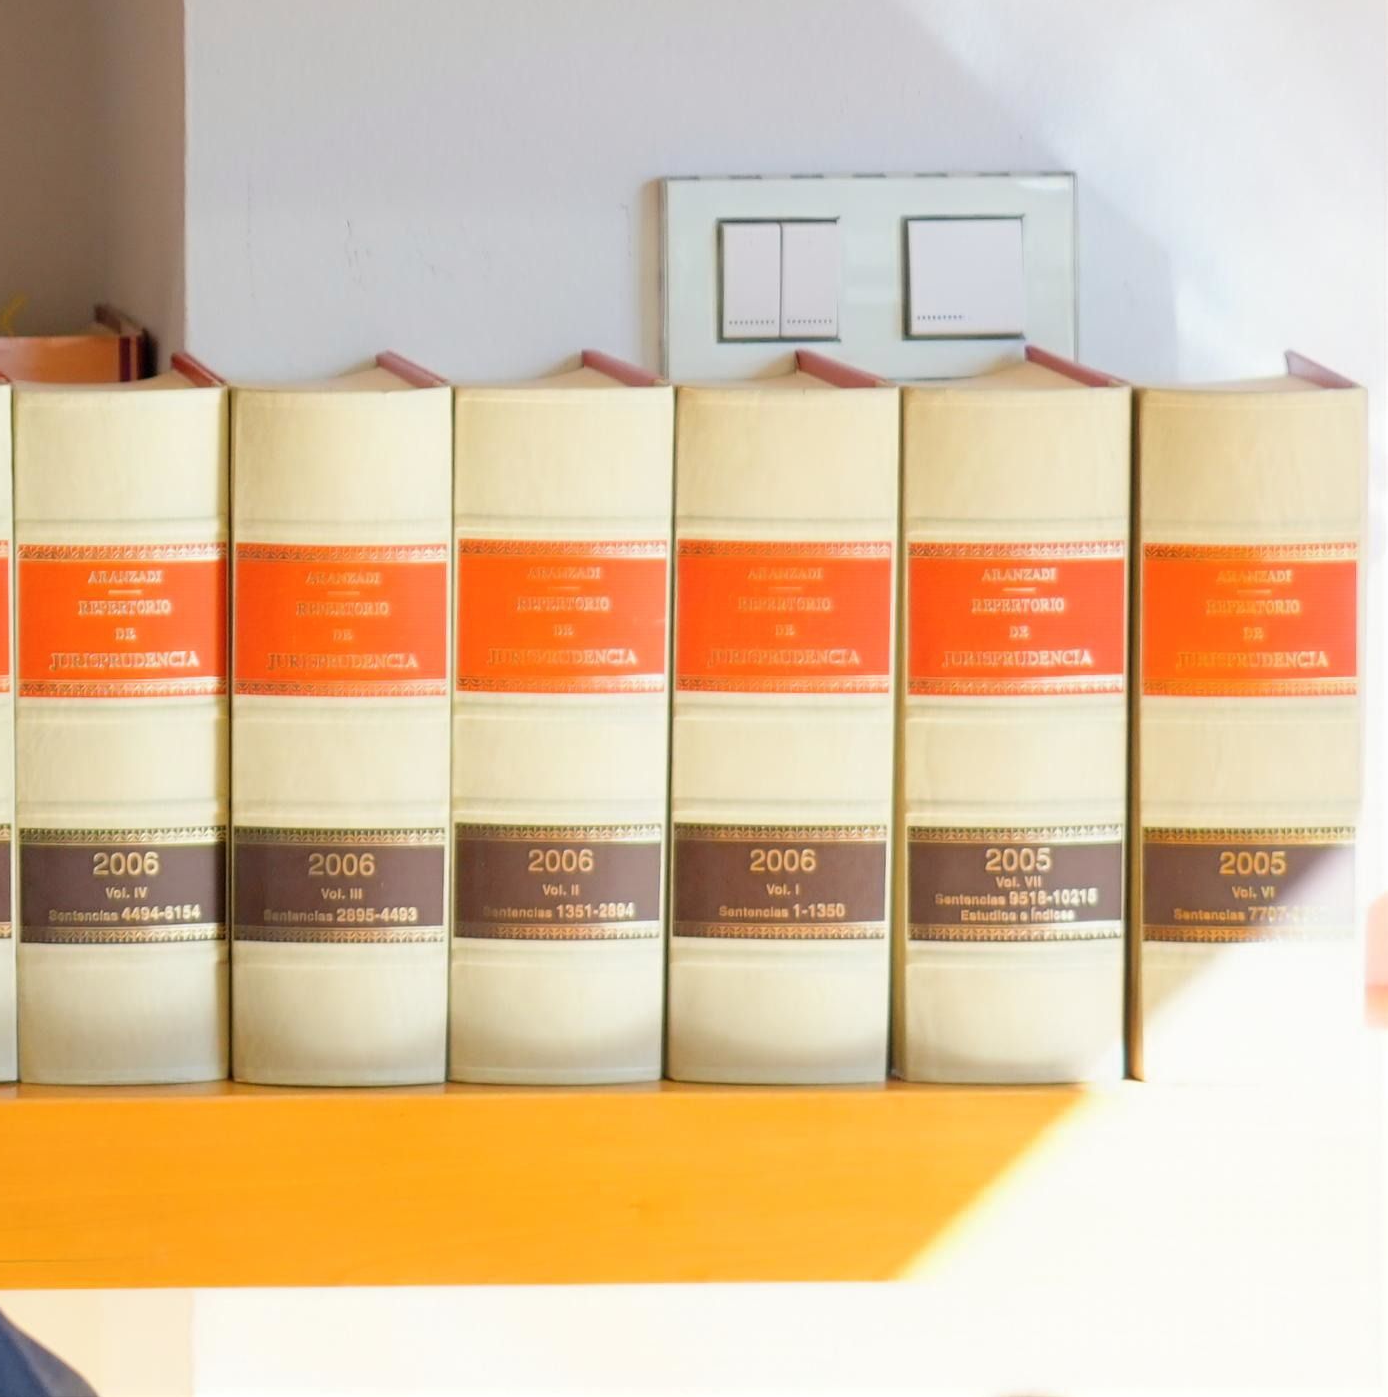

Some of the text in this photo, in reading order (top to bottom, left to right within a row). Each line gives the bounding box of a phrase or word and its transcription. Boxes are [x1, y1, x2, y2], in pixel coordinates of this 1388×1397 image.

[92, 852, 160, 876] 2006
[308, 853, 375, 876] 2006
[528, 849, 594, 872] 2006
[749, 849, 816, 872] 2006
[985, 848, 1052, 872] 2005
[1219, 851, 1286, 875] 2005
[542, 884, 579, 896] Vol. II
[766, 884, 792, 895] Vol.
[995, 876, 1041, 888] Vol. VII
[106, 887, 148, 899] Vol. IV
[321, 888, 362, 900] Vol. III
[1232, 886, 1275, 898] Vol. VI
